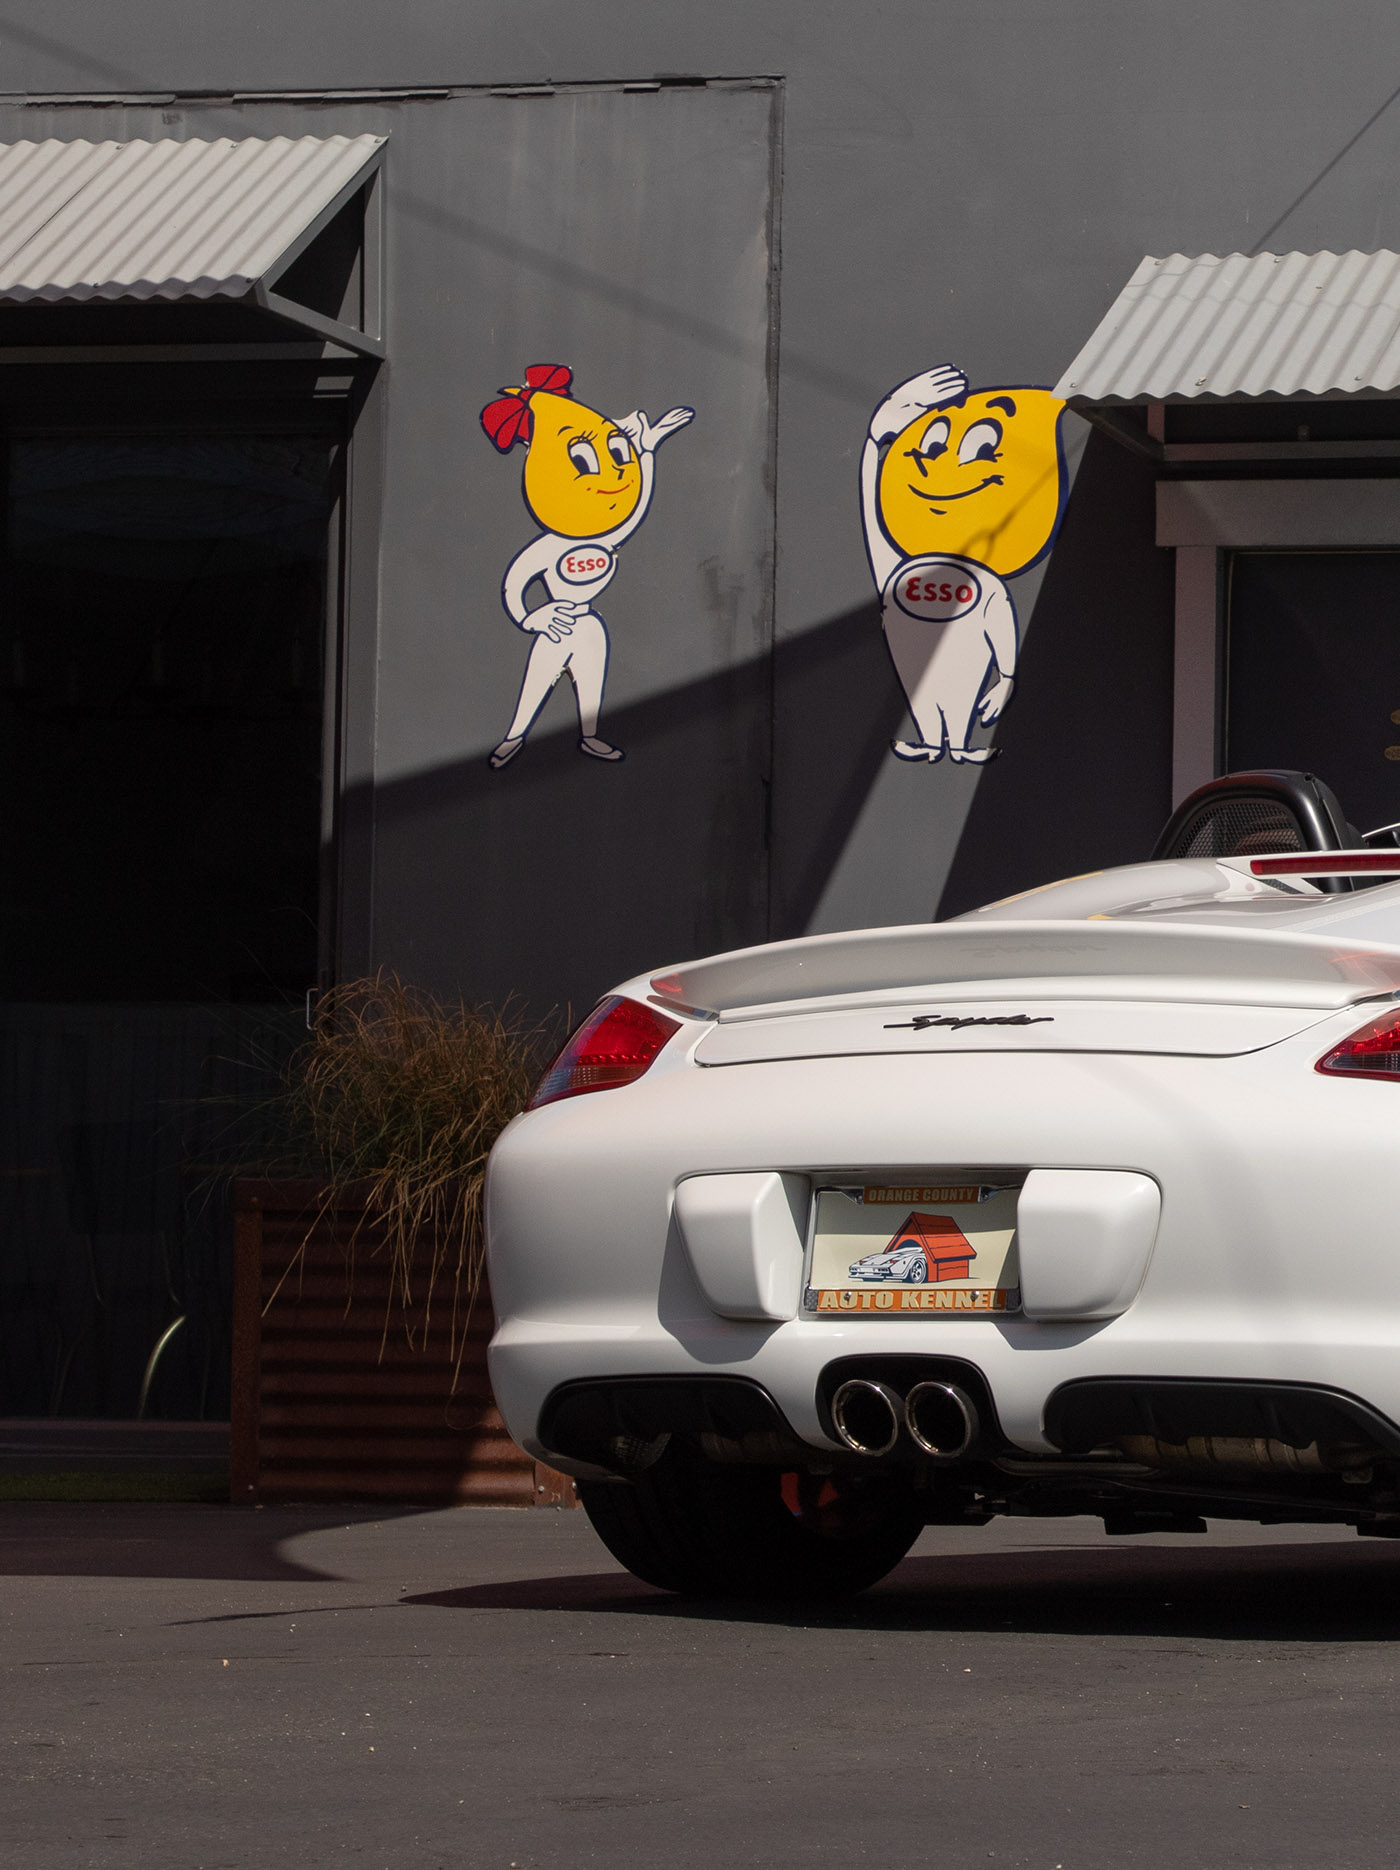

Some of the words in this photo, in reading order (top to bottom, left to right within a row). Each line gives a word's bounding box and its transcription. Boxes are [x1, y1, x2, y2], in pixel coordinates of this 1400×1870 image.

[869, 1188, 920, 1202] ORANGE
[922, 1187, 974, 1201] COUNTY
[819, 1290, 894, 1310] AUTO
[900, 1290, 1003, 1310] KENNEL
